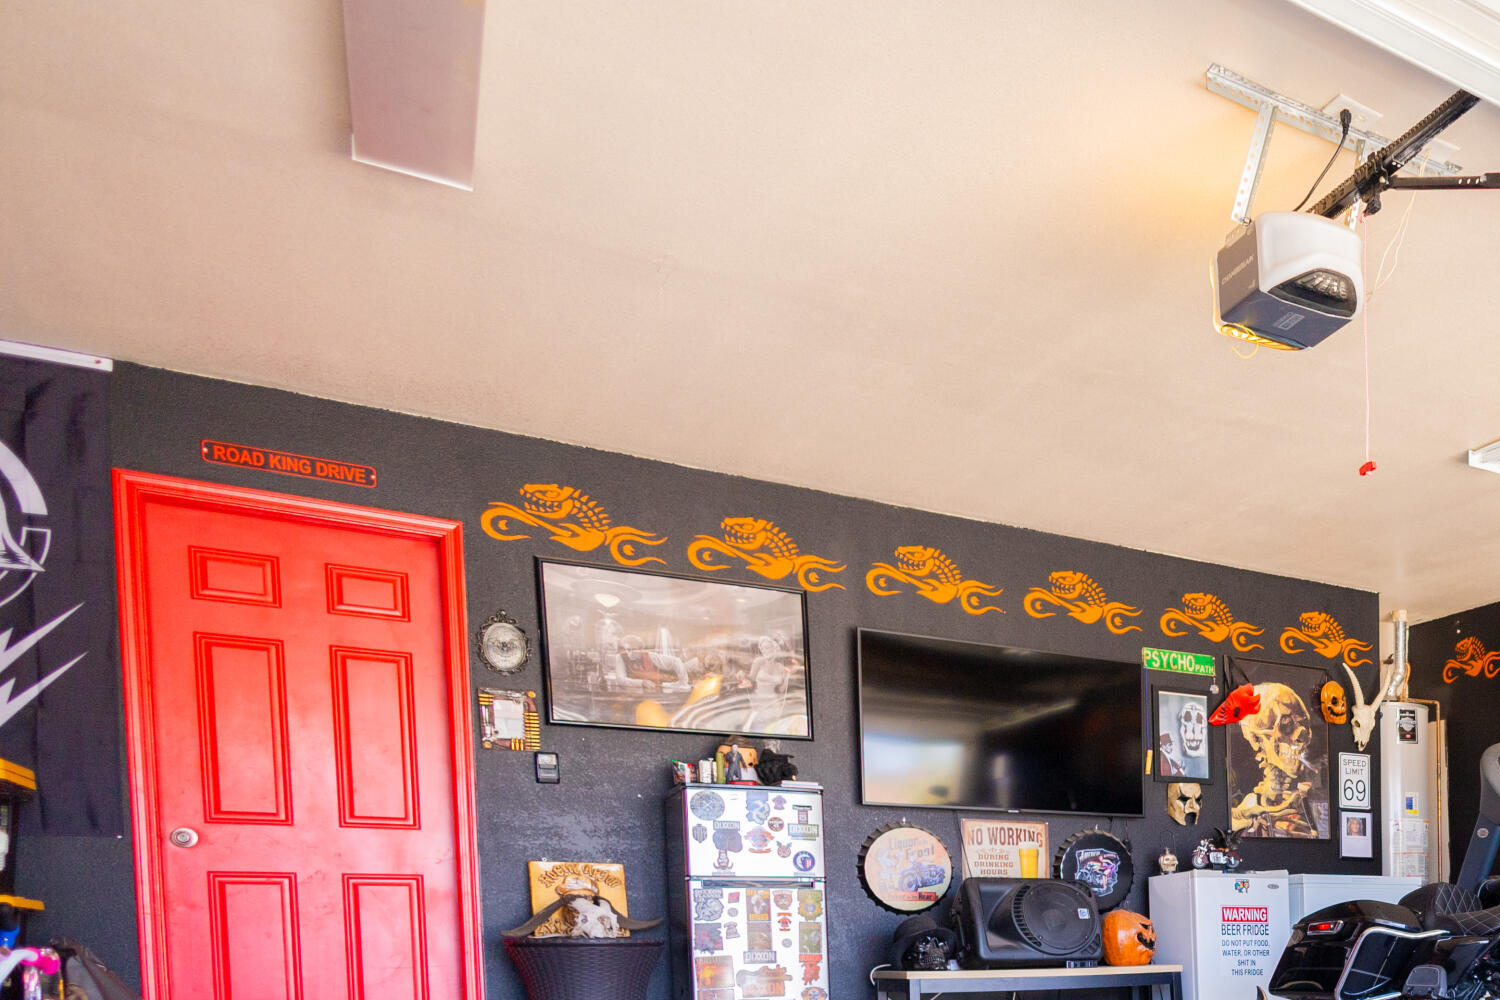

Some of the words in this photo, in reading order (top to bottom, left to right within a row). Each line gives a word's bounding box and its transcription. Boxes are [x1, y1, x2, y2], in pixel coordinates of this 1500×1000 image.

[213, 444, 265, 466] ROAD
[269, 455, 312, 474] KING
[315, 462, 366, 483] DRIVE
[1144, 650, 1195, 671] PSYCHO
[1343, 759, 1366, 767] SPEED
[1344, 779, 1366, 801] 69
[968, 828, 983, 846] NO
[987, 827, 1043, 847] WORKING
[978, 853, 1009, 861] DURING
[1223, 908, 1267, 921] WARNING
[1221, 925, 1241, 936] BEER
[1243, 925, 1269, 936] FRIDGE
